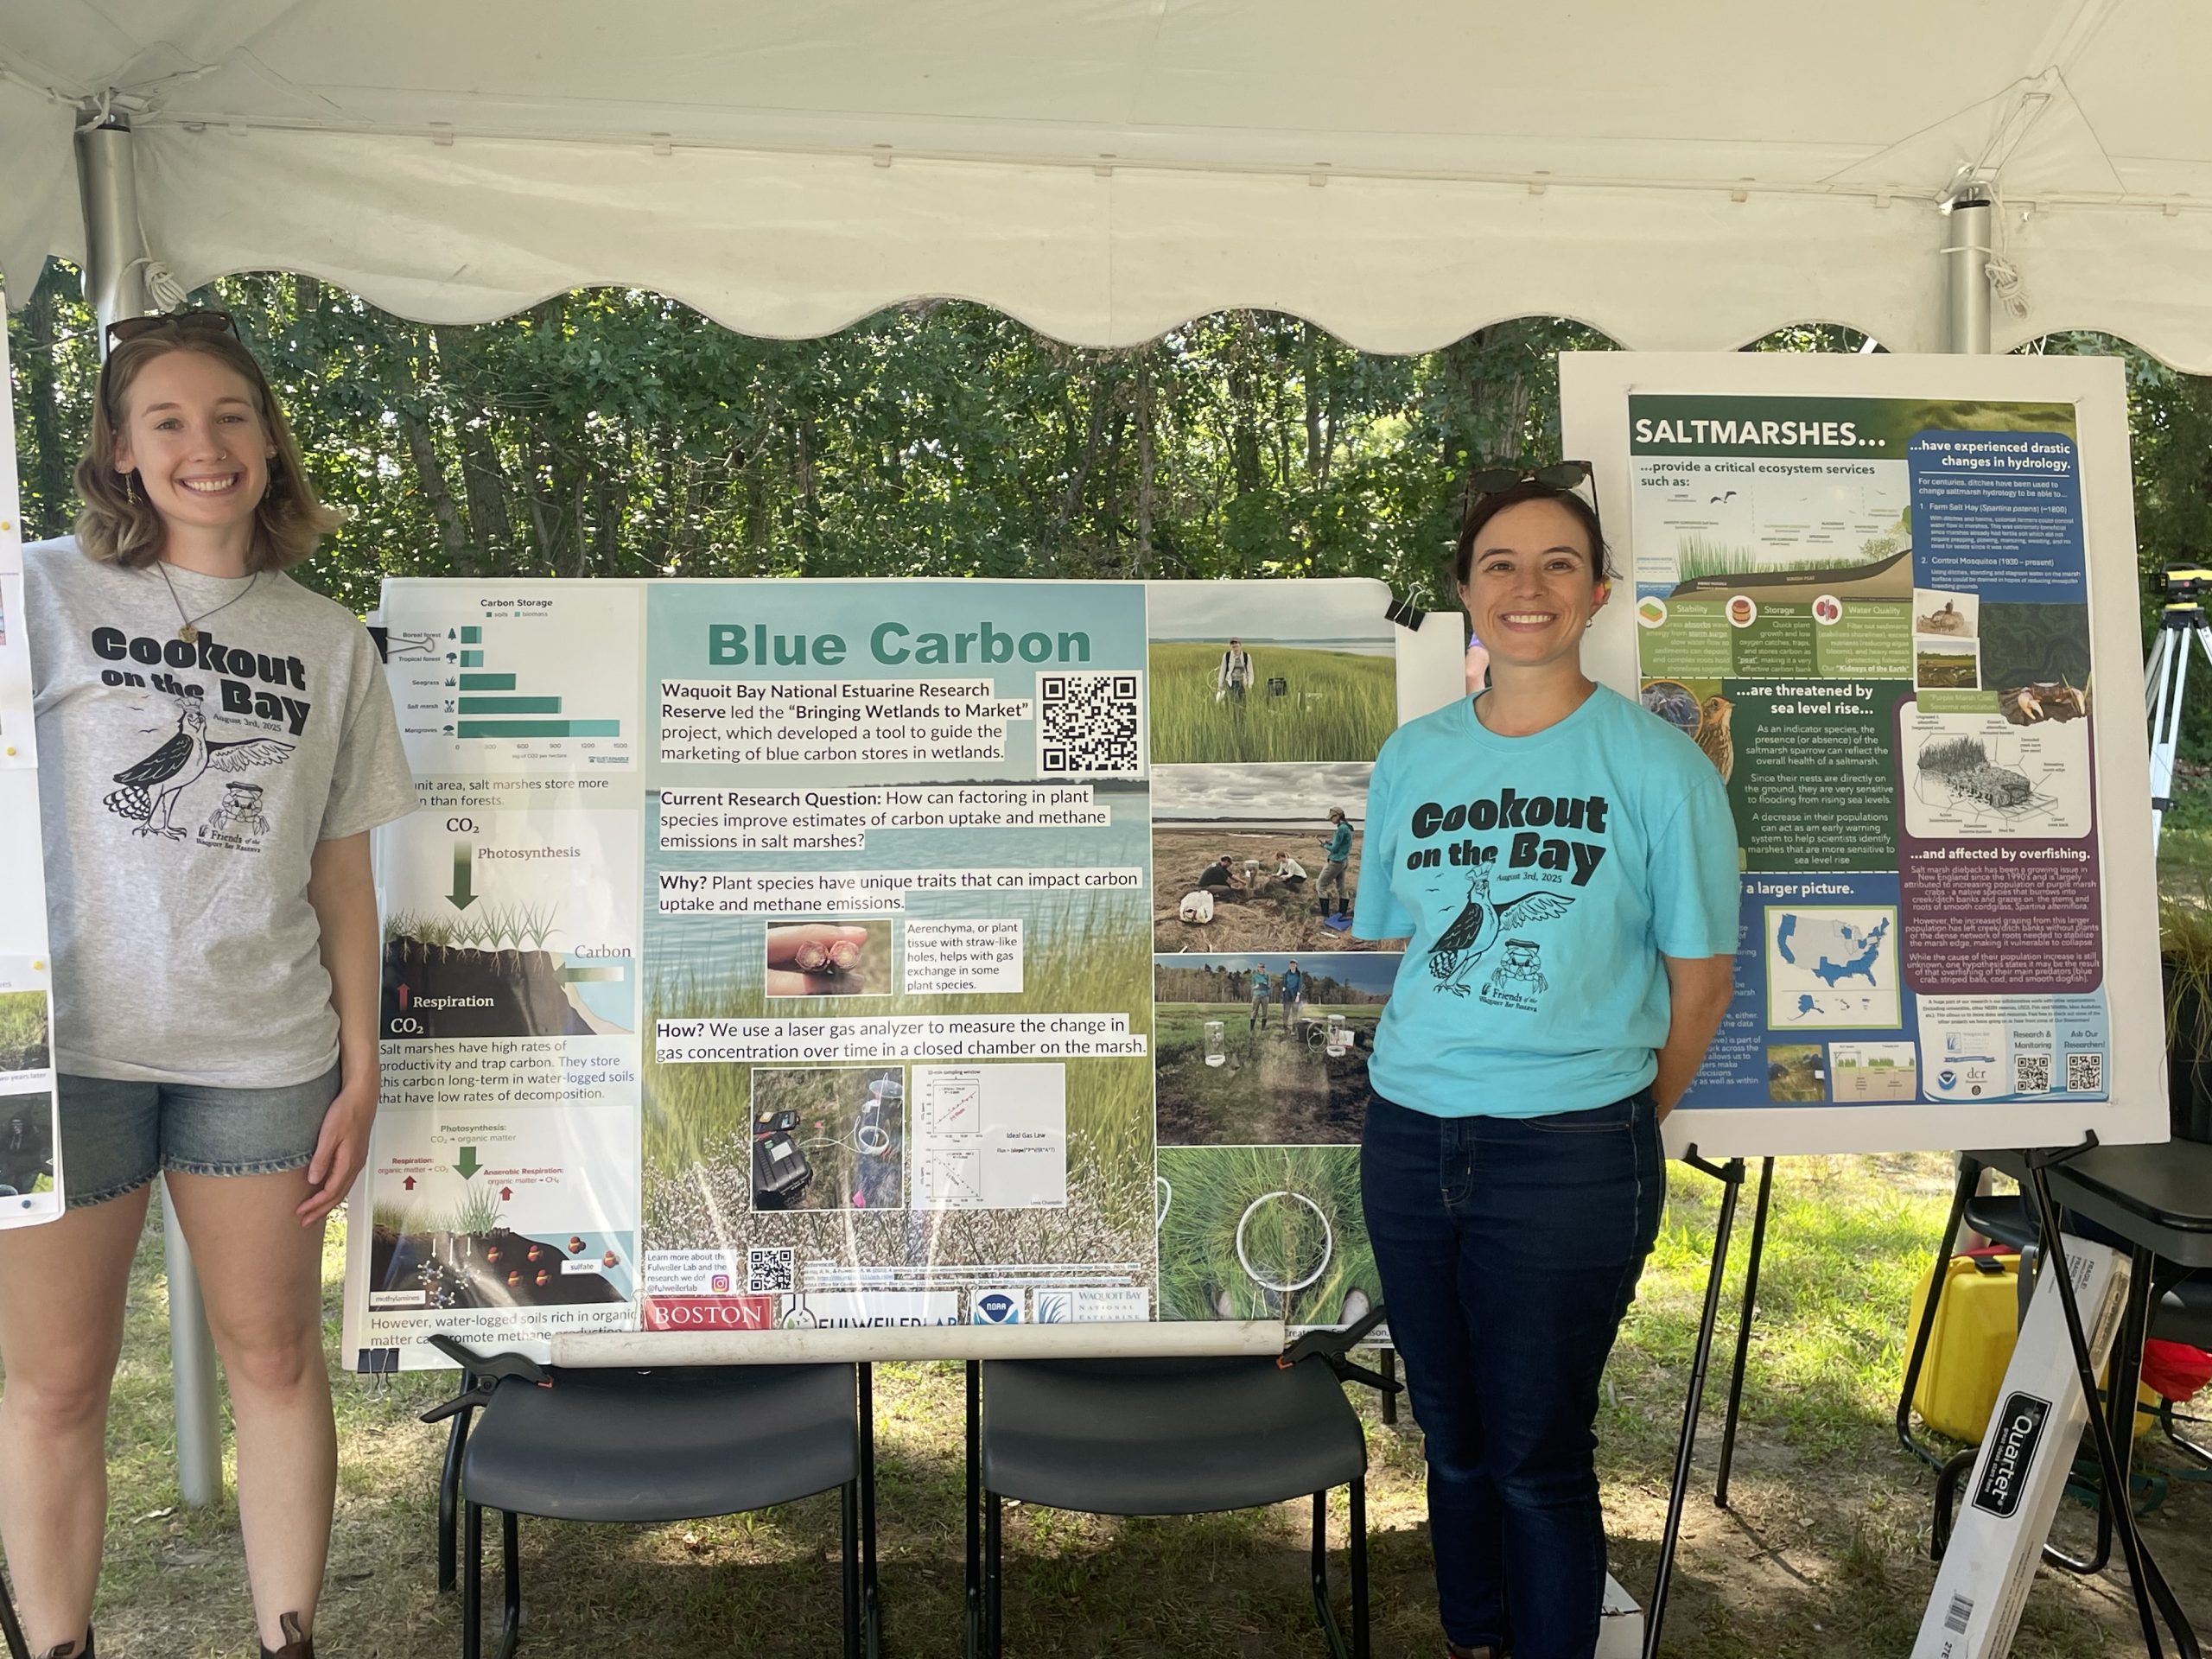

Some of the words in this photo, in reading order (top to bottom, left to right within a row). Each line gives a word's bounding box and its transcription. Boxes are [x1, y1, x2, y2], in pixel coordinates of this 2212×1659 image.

[1636, 419, 1885, 446] SALTMARSHES...
[1910, 440, 1950, 450] ...have
[1955, 441, 2027, 454] experienced
[2031, 442, 2069, 453] drastic
[1641, 461, 1700, 474] ...provide
[1714, 461, 1754, 472] critical
[1758, 465, 1822, 475] ecosystem
[1826, 464, 1874, 474] services
[1942, 454, 1990, 468] changes
[1993, 456, 2004, 467] in
[2008, 456, 2069, 471] hydrology.
[1641, 476, 1669, 486] such
[517, 599, 552, 607] Storage
[1677, 604, 1707, 615] Stability
[1764, 607, 1794, 615] Storage
[1872, 606, 1899, 615] Quality
[709, 624, 846, 665] Blue
[870, 621, 1090, 664] Carbon
[92, 626, 306, 690] Cookout
[662, 683, 731, 700] Waquoit
[737, 684, 766, 700] Bay
[772, 684, 836, 697] National
[842, 683, 913, 697] Estuarine
[919, 683, 988, 696] Research
[1776, 683, 1851, 696] threatened
[1856, 684, 1872, 699] by
[101, 670, 144, 688] on
[151, 673, 204, 701] the
[221, 678, 311, 735] Bay
[1798, 702, 1830, 713] level
[1835, 702, 1872, 714] rise...
[663, 704, 725, 718] Reserve
[731, 705, 753, 718] led
[760, 705, 783, 718] the
[865, 703, 939, 717] Wetlands
[944, 705, 960, 717] to
[213, 714, 240, 727] August
[244, 718, 259, 728] 3rd,
[264, 722, 281, 732] 2025
[1783, 724, 1821, 733] indicator
[1824, 726, 1859, 734] species,
[1860, 725, 1874, 734] the
[436, 782, 465, 791] area,
[469, 779, 489, 790] salt
[493, 779, 541, 789] marshes
[544, 779, 574, 788] store
[430, 796, 456, 805] than
[461, 795, 505, 805] forests.
[661, 792, 722, 805] Current
[728, 792, 799, 805] Research
[805, 791, 880, 808] Question:
[887, 791, 922, 804] How
[927, 793, 952, 804] can
[959, 790, 1027, 805] factoring
[1033, 790, 1044, 803] in
[1051, 789, 1088, 805] plant
[1412, 788, 1608, 838] Cookout
[211, 830, 242, 843] Friends
[478, 846, 580, 861] Photosynthesis
[1407, 846, 1441, 870] on
[1449, 840, 1498, 867] the
[1509, 832, 1605, 887] Bay
[1910, 848, 1945, 858] ...and
[1948, 847, 1997, 858] affected
[2001, 848, 2016, 861] by
[2019, 848, 2089, 861] overfishing.
[659, 875, 706, 892] Why?
[713, 876, 752, 889] Plant
[757, 876, 813, 892] species
[819, 875, 855, 889] have
[861, 874, 912, 890] unique
[917, 874, 956, 887] traits
[961, 873, 991, 886] that
[997, 876, 1022, 886] can
[1028, 873, 1079, 888] impact
[1084, 872, 1136, 885] carbon
[1497, 873, 1520, 882] August
[1522, 872, 1539, 881] 3rd,
[1541, 874, 1562, 883] 2025
[1746, 885, 1753, 893] a
[1758, 881, 1797, 897] larger
[1802, 881, 1853, 897] picture.
[907, 924, 974, 934] Aerenchyma,
[992, 923, 1017, 933] plant
[575, 945, 630, 958] Carbon
[907, 981, 932, 992] plant
[936, 980, 976, 990] species.
[413, 995, 493, 1009] Respiration
[1493, 988, 1522, 1002] Friends
[380, 1043, 400, 1054] Salt
[404, 1043, 454, 1053] marshes
[459, 1042, 487, 1052] have
[492, 1041, 517, 1054] high
[521, 1042, 550, 1051] rates
[554, 1040, 566, 1051] of
[1967, 1067, 1986, 1078] dcr
[441, 1124, 505, 1133] Photosynthesis:
[654, 1306, 761, 1325] BOSTON
